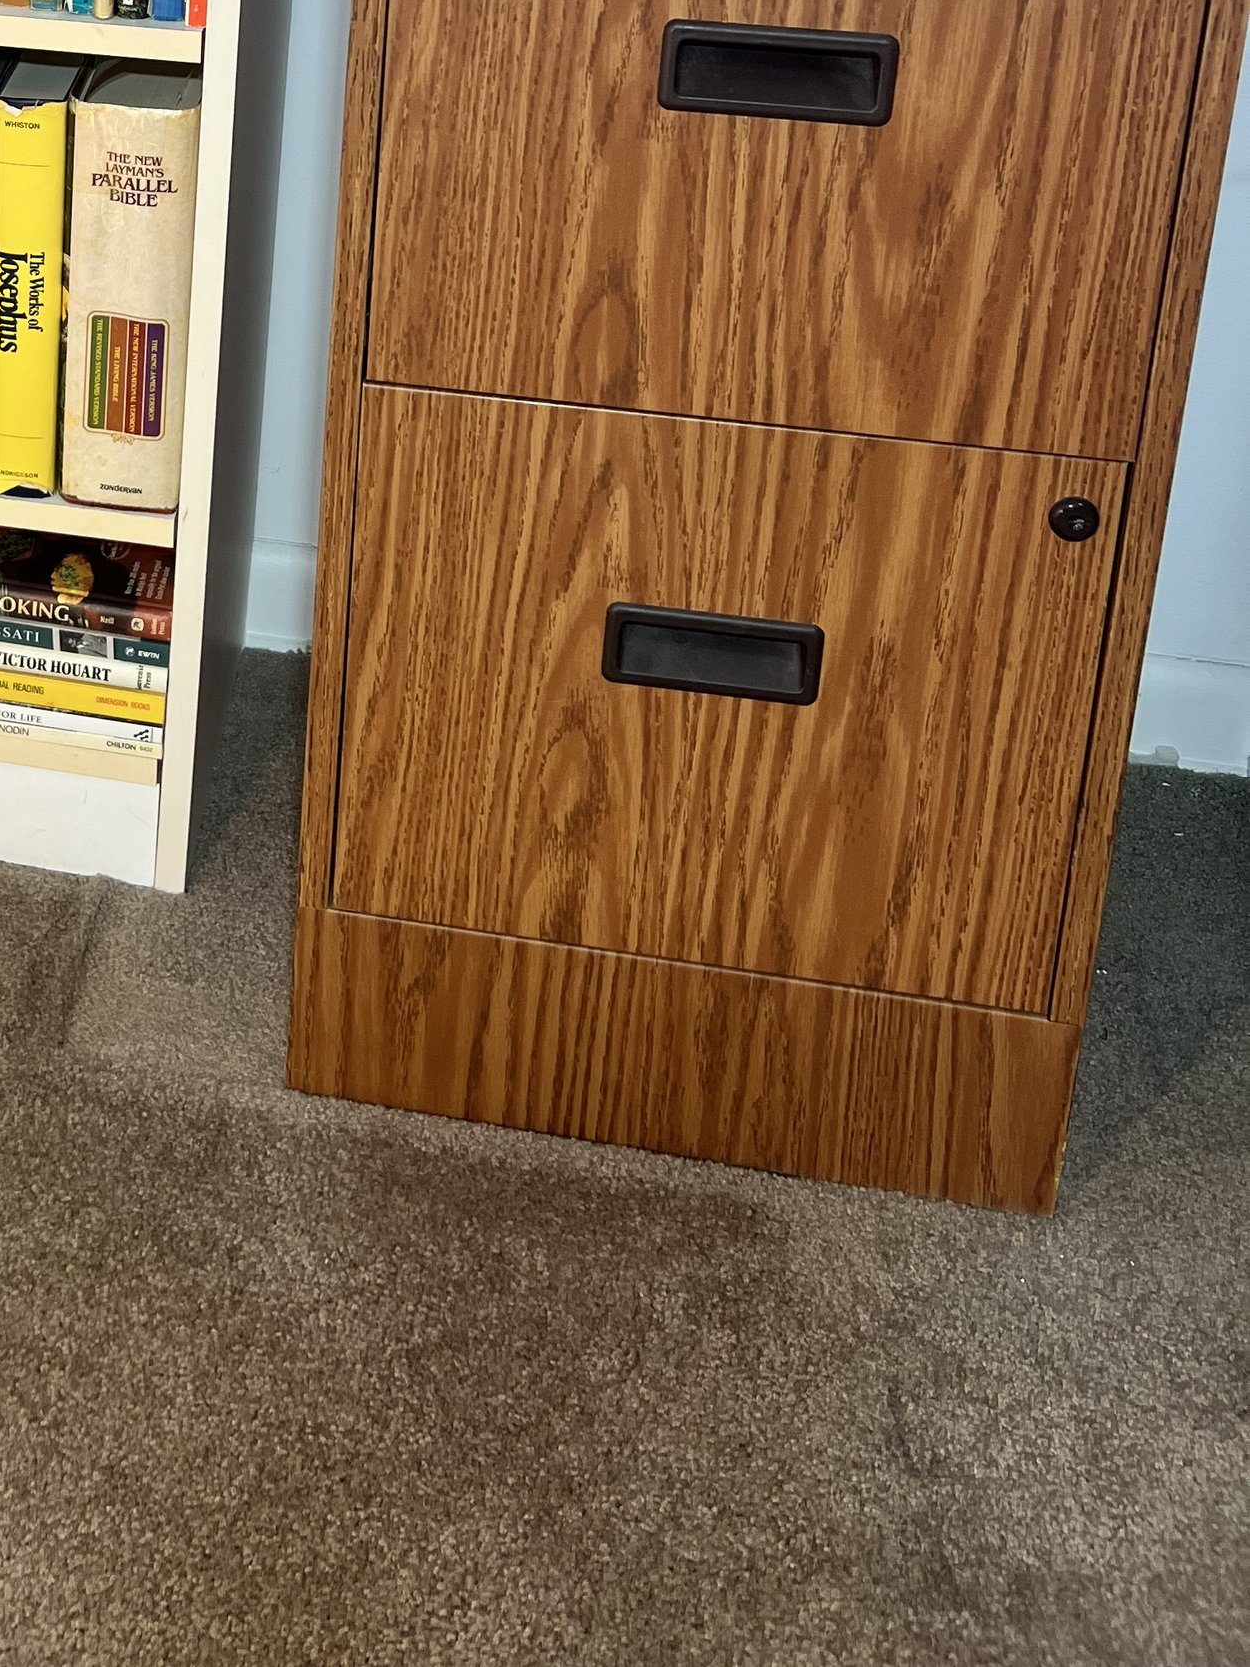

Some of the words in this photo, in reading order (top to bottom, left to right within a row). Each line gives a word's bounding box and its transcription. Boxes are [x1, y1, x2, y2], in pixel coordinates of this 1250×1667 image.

[4, 120, 40, 130] WHISTON
[107, 151, 131, 164] THE
[135, 155, 163, 167] NEW
[105, 163, 164, 178] LAYMAN'S
[91, 173, 179, 194] PARALLEL
[109, 189, 158, 207] BIBLE
[29, 252, 45, 276] The
[28, 277, 45, 320] Works
[27, 318, 44, 332] of
[50, 659, 112, 682] HOUART
[20, 713, 42, 723] LIFE
